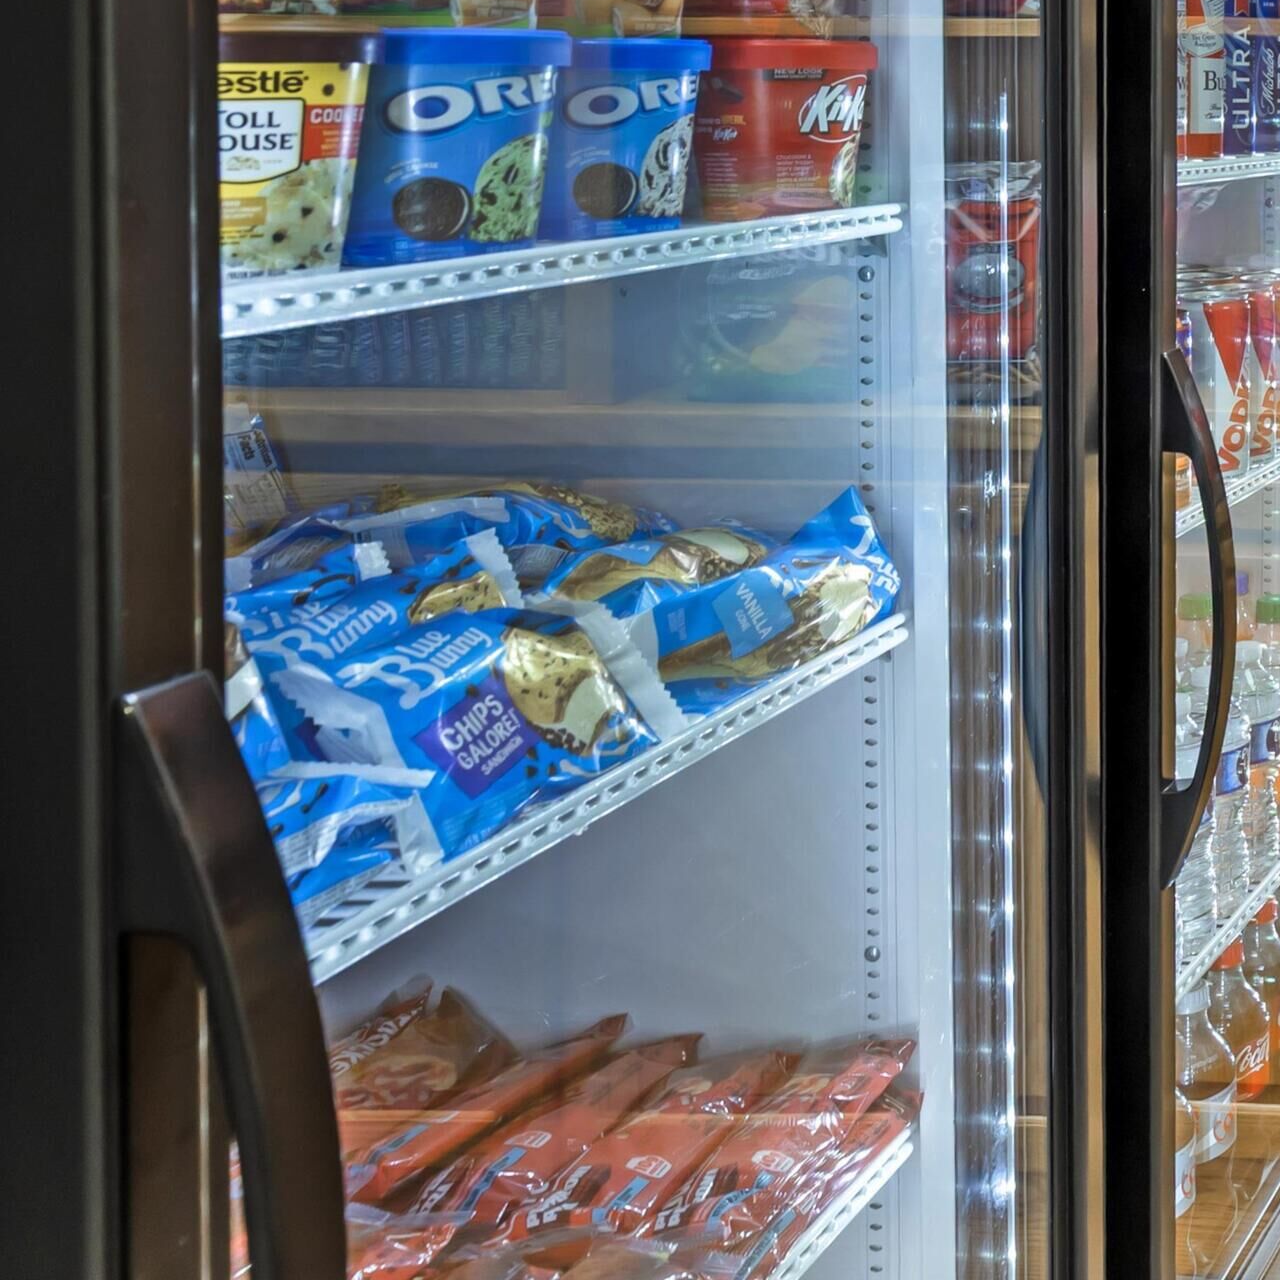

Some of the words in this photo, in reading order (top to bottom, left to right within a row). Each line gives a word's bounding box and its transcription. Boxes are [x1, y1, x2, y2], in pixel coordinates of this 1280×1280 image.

[217, 70, 304, 95] estlé
[1231, 24, 1250, 130] ULTRA
[218, 132, 297, 152] OUSE
[733, 582, 776, 641] VANILLA
[439, 694, 505, 752] CHIPS
